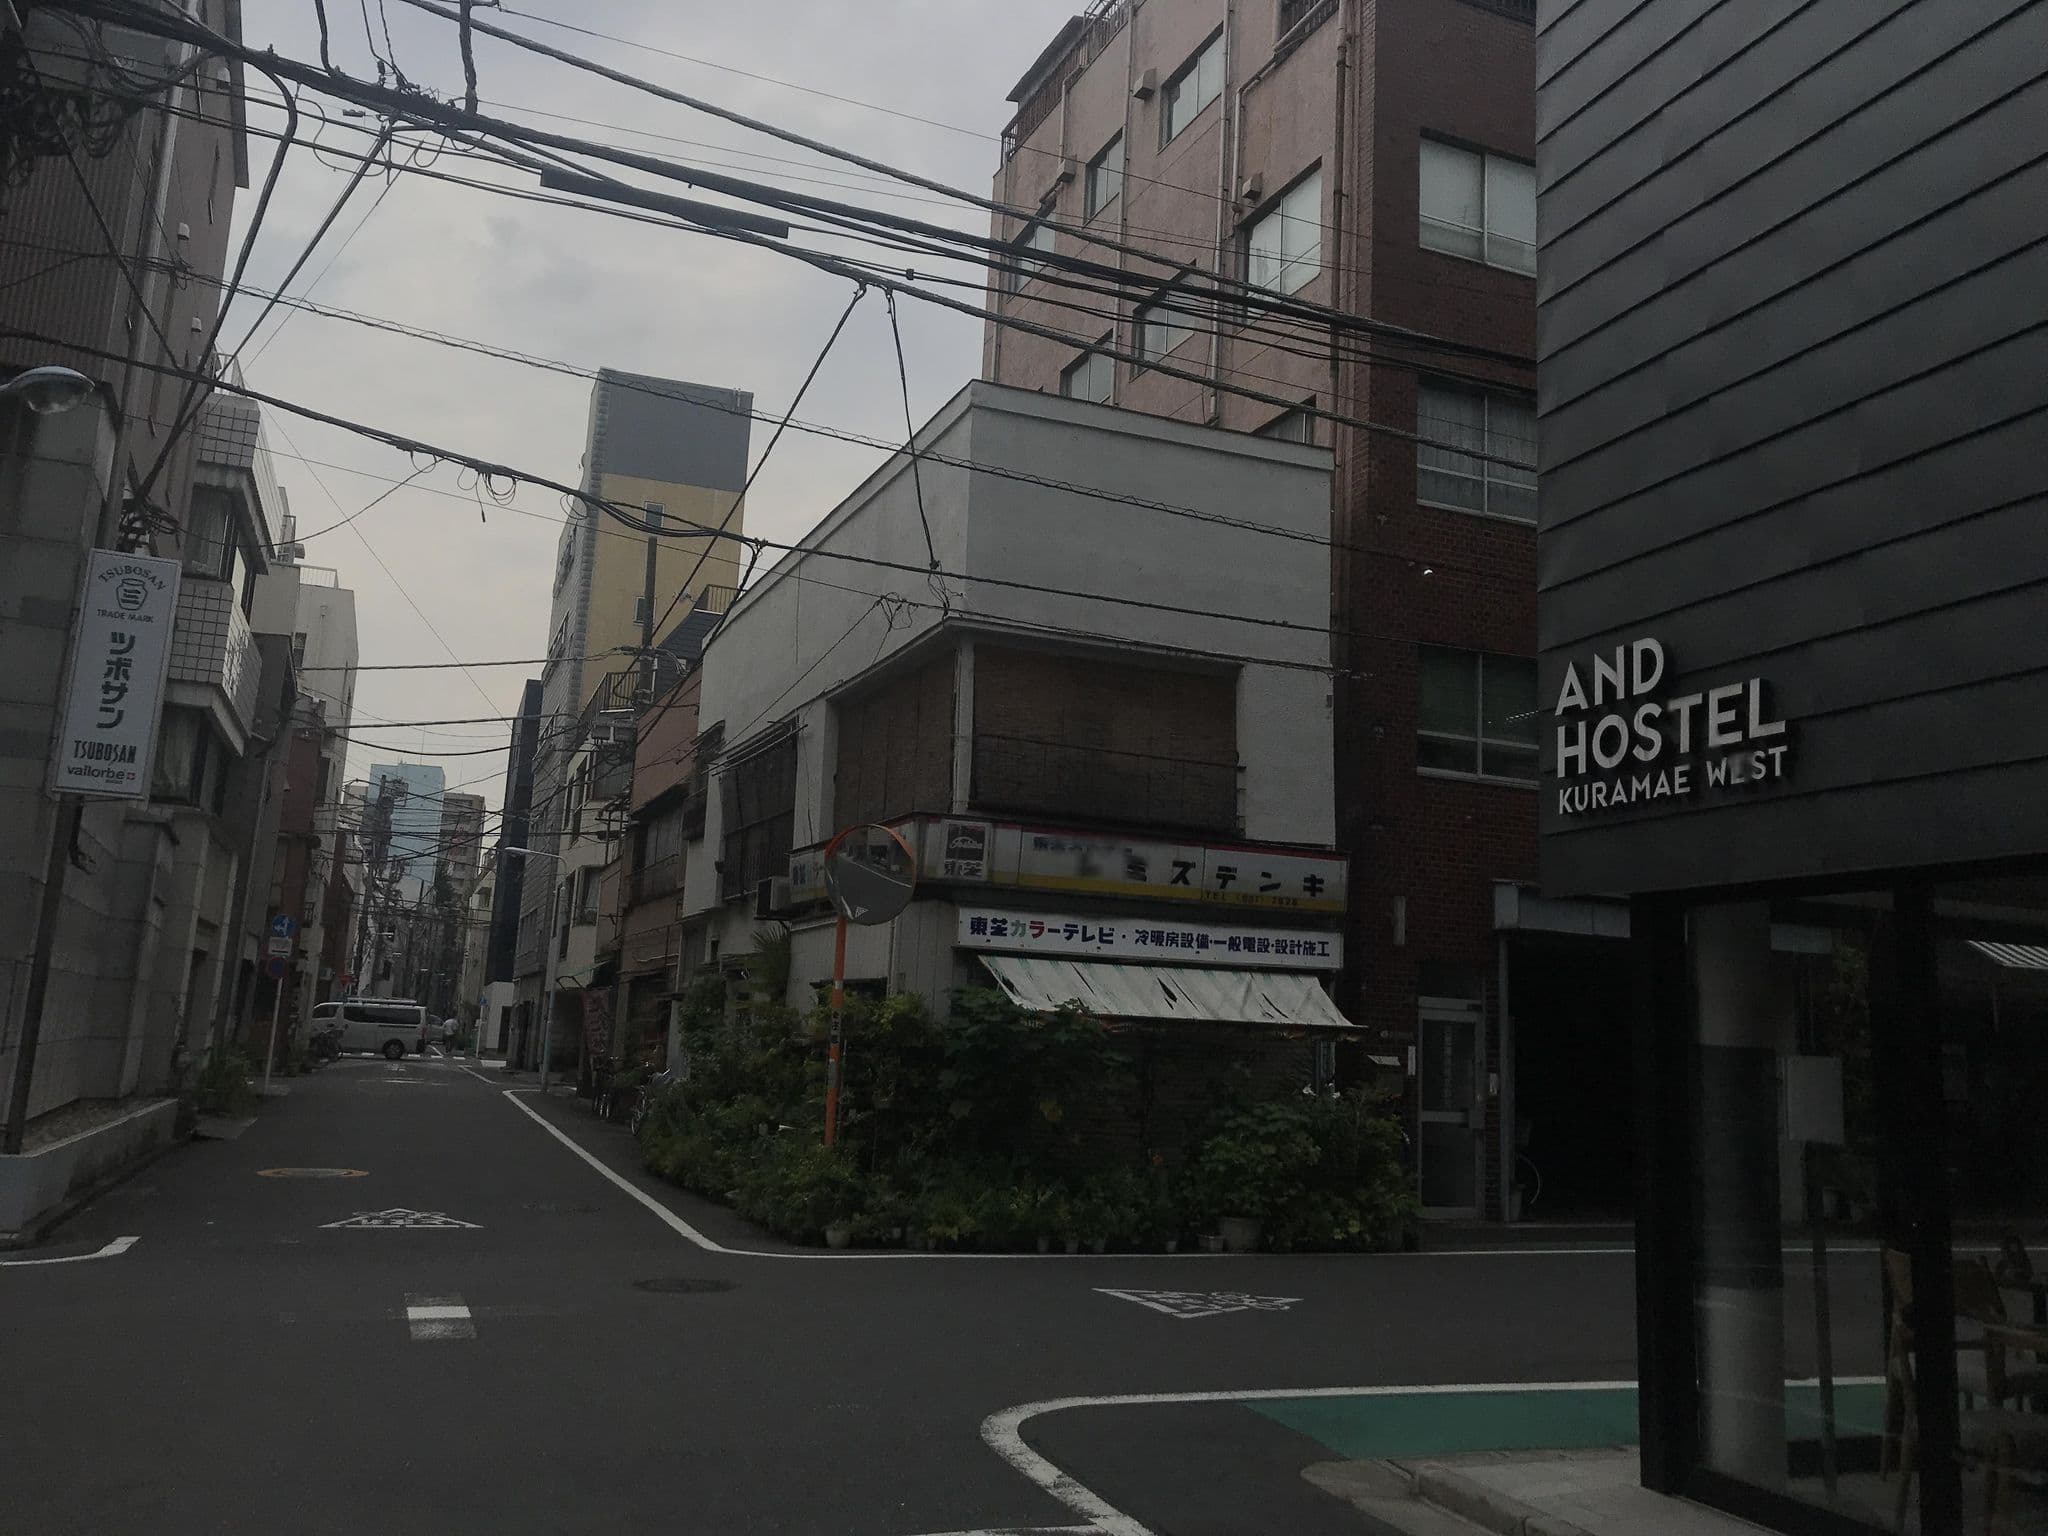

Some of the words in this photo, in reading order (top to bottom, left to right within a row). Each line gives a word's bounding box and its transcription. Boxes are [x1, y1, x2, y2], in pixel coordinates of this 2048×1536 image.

[98, 565, 166, 591] TSUBOSAN
[96, 609, 127, 620] TRADE
[127, 613, 154, 623] MARK
[96, 631, 136, 729] ツボサン
[1554, 637, 1665, 716] AND
[73, 740, 137, 764] TSUBOSAN
[1556, 677, 1787, 779] HOSTEL
[1558, 762, 1692, 816] KURAMAE
